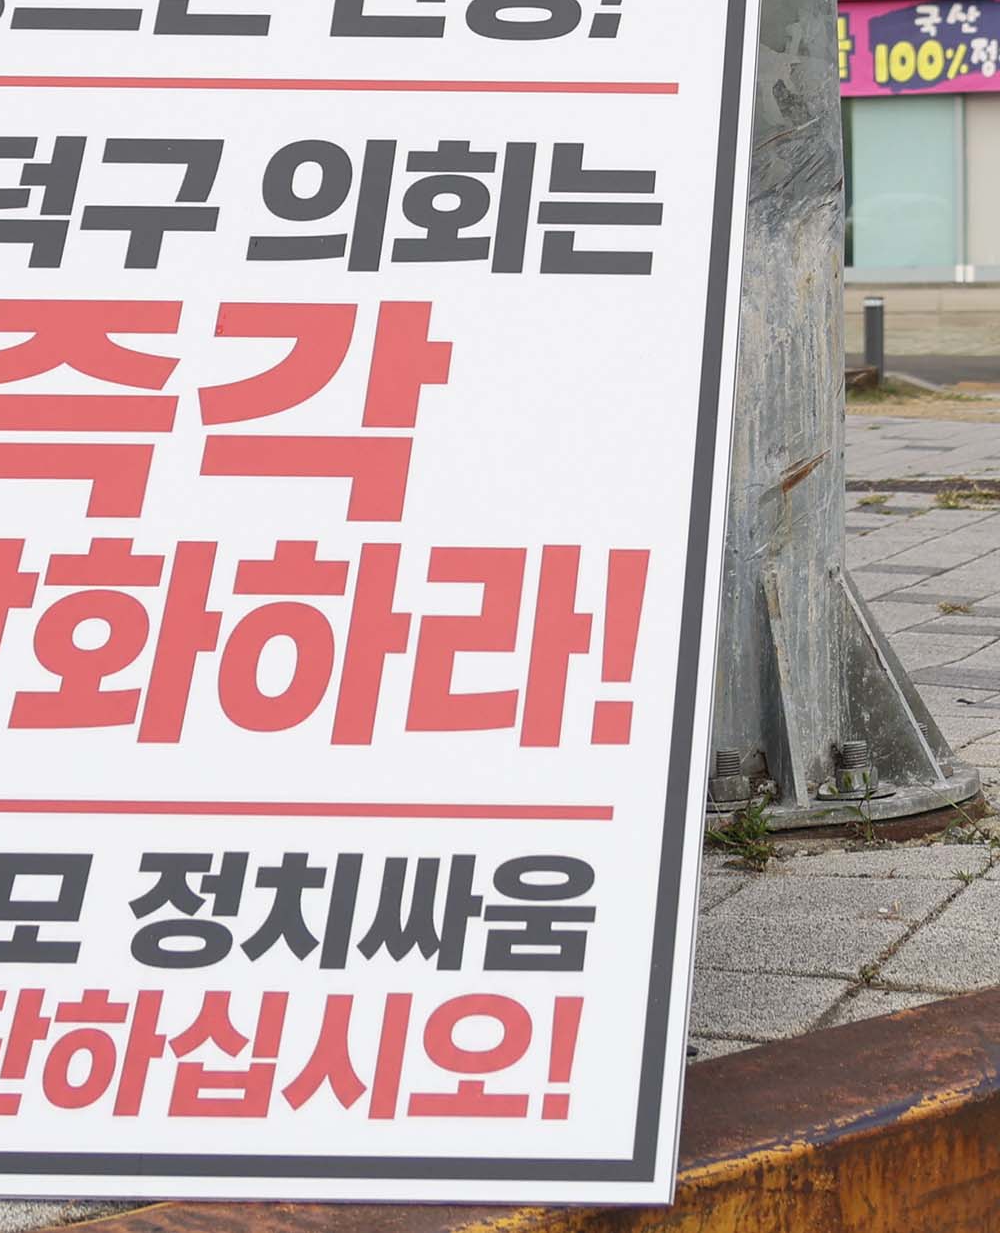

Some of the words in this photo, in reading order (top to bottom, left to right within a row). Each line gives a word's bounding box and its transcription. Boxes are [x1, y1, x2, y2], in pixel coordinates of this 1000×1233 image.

[914, 3, 981, 37] 국산
[874, 40, 969, 84] 100%
[129, 852, 596, 971] 정치싸움
